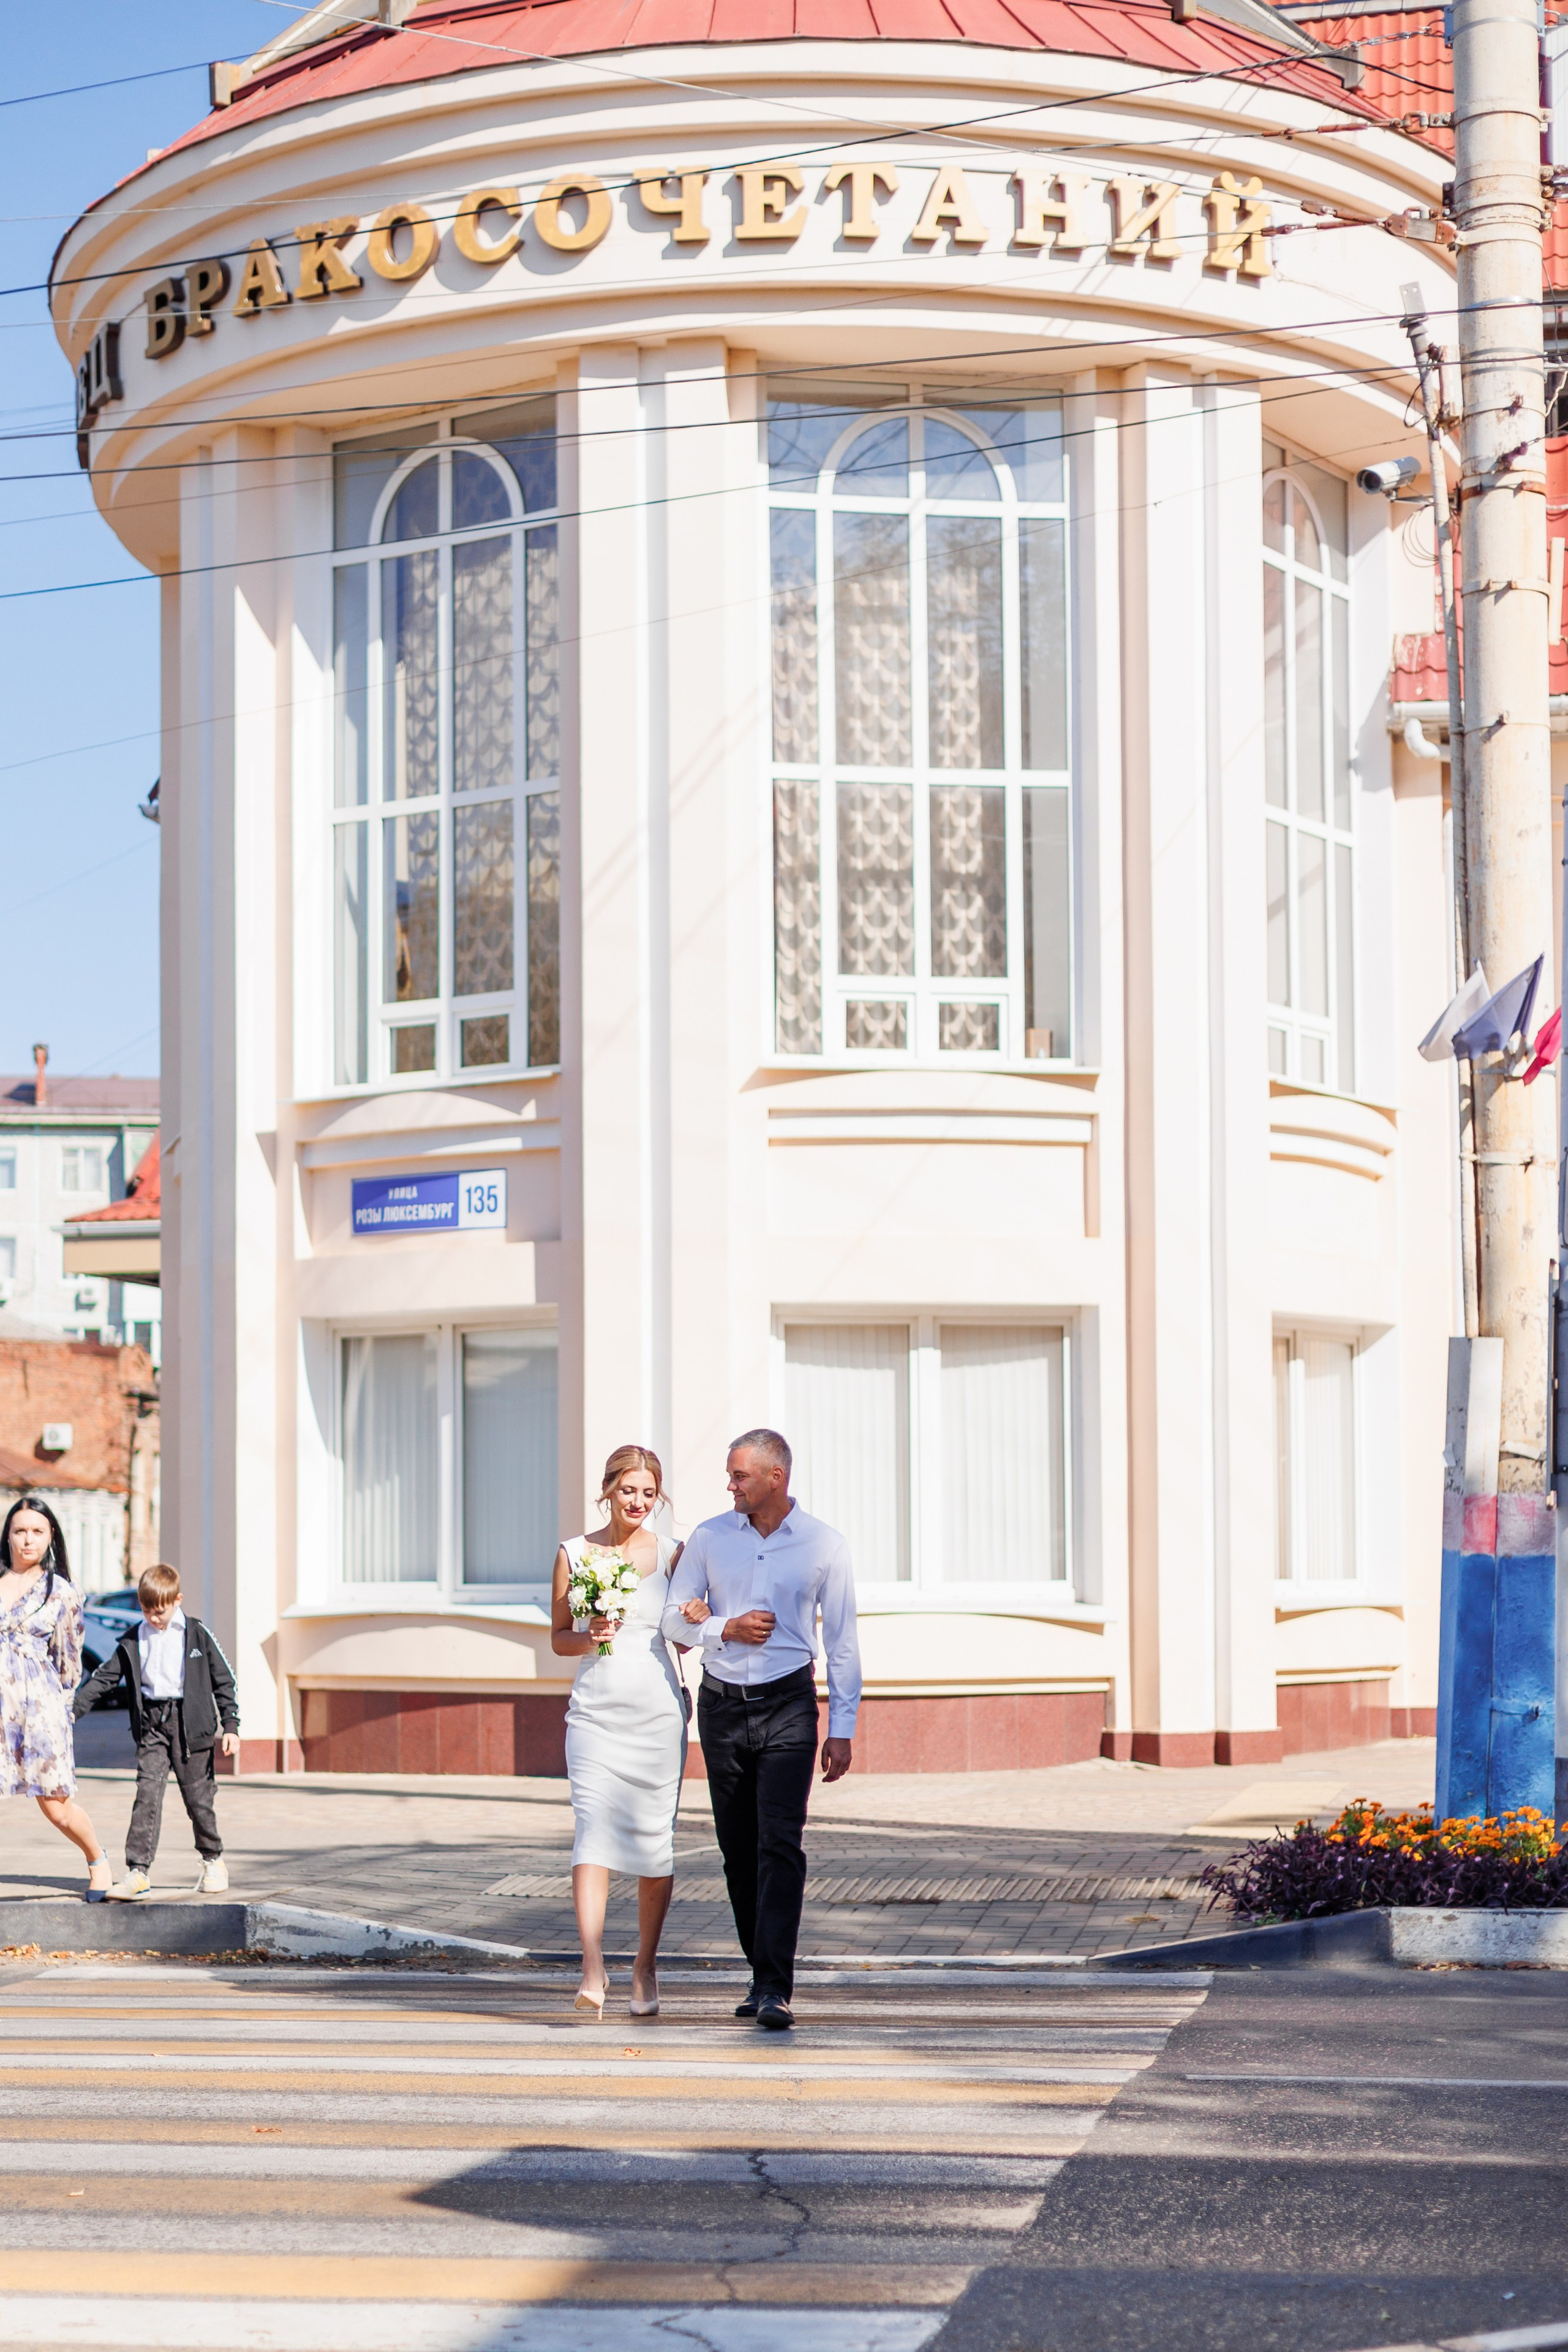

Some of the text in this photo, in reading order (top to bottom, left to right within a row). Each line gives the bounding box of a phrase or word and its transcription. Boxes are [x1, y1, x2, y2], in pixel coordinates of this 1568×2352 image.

[143, 161, 1273, 359] БРАКОСОЧЕТАНИЙ
[388, 1186, 418, 1199] УЛИЦА
[465, 1185, 498, 1213] 135
[356, 1202, 454, 1224] РОЗЫ ЛЮКСЕМБУРГ
